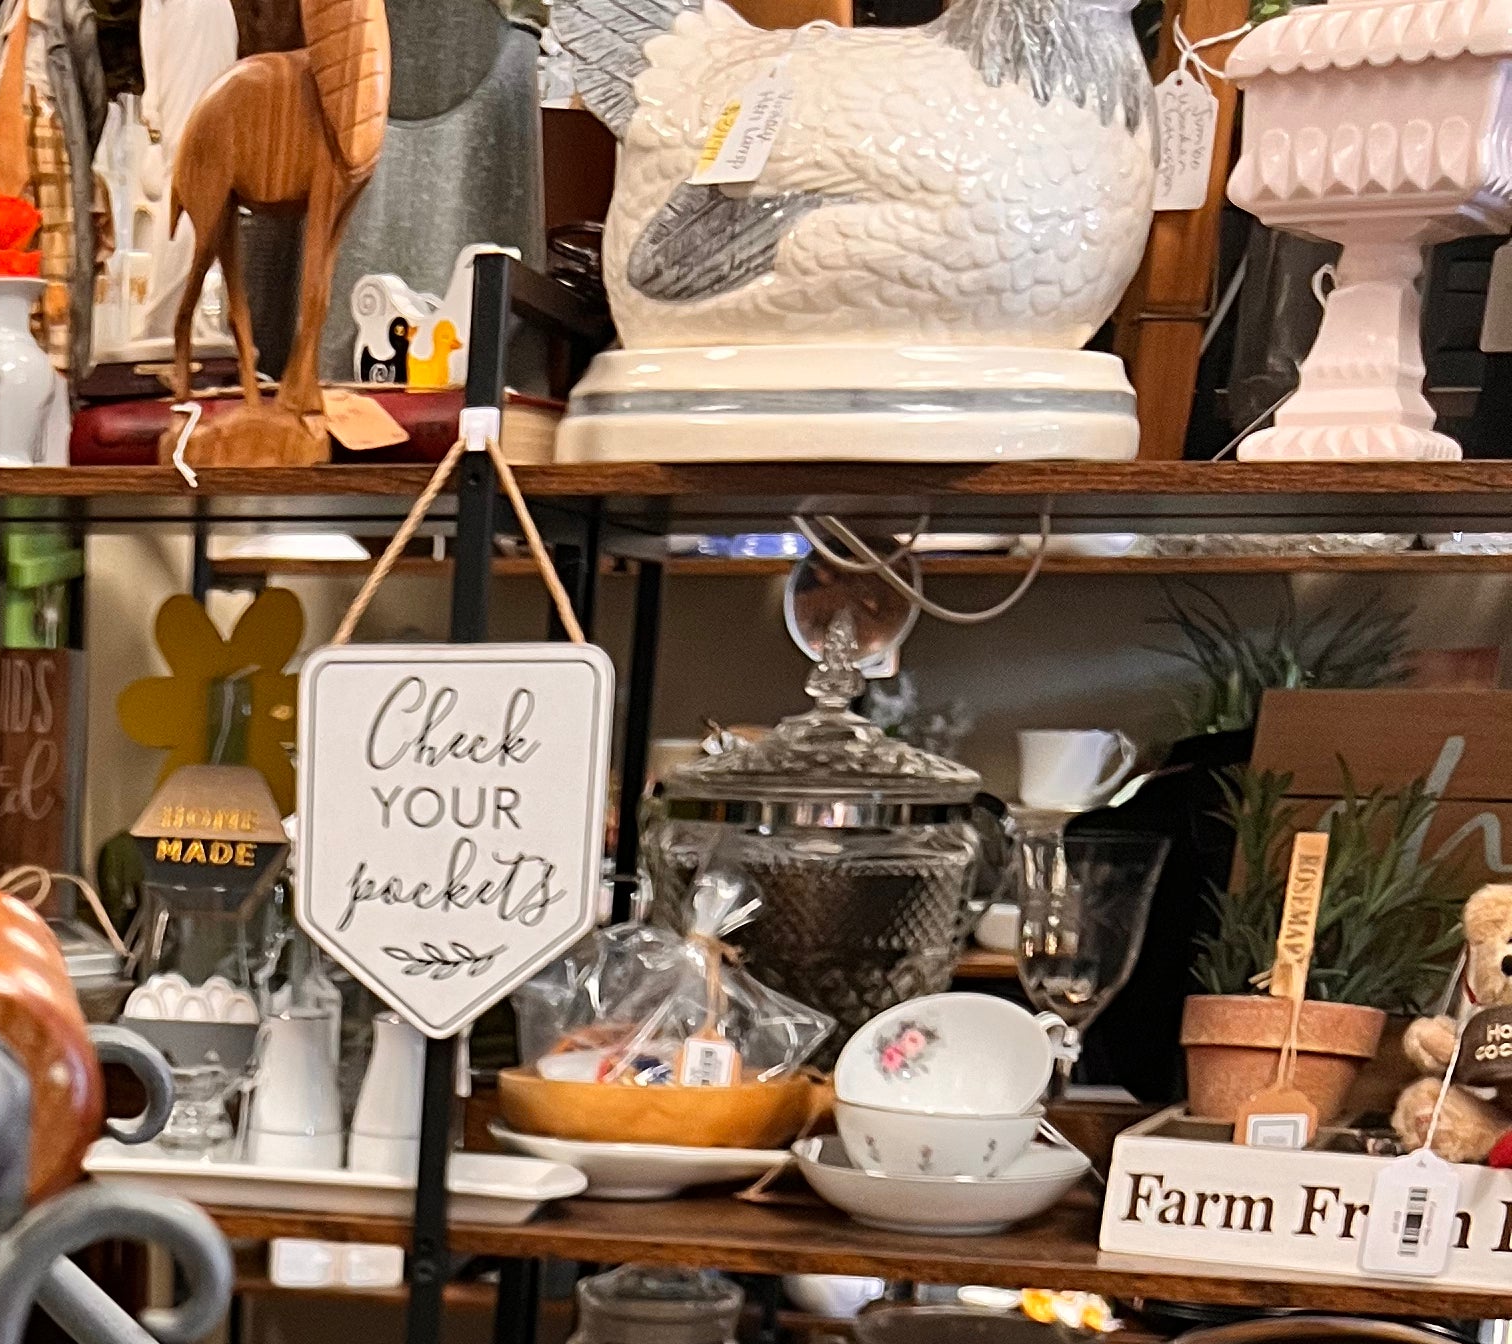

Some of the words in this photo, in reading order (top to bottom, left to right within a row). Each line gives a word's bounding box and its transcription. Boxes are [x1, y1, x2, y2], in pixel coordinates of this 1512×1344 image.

[365, 676, 541, 770] Check
[371, 785, 522, 829] YOUR
[155, 838, 257, 867] MADE
[335, 837, 567, 932] pockets
[1121, 1173, 1274, 1232] Farm
